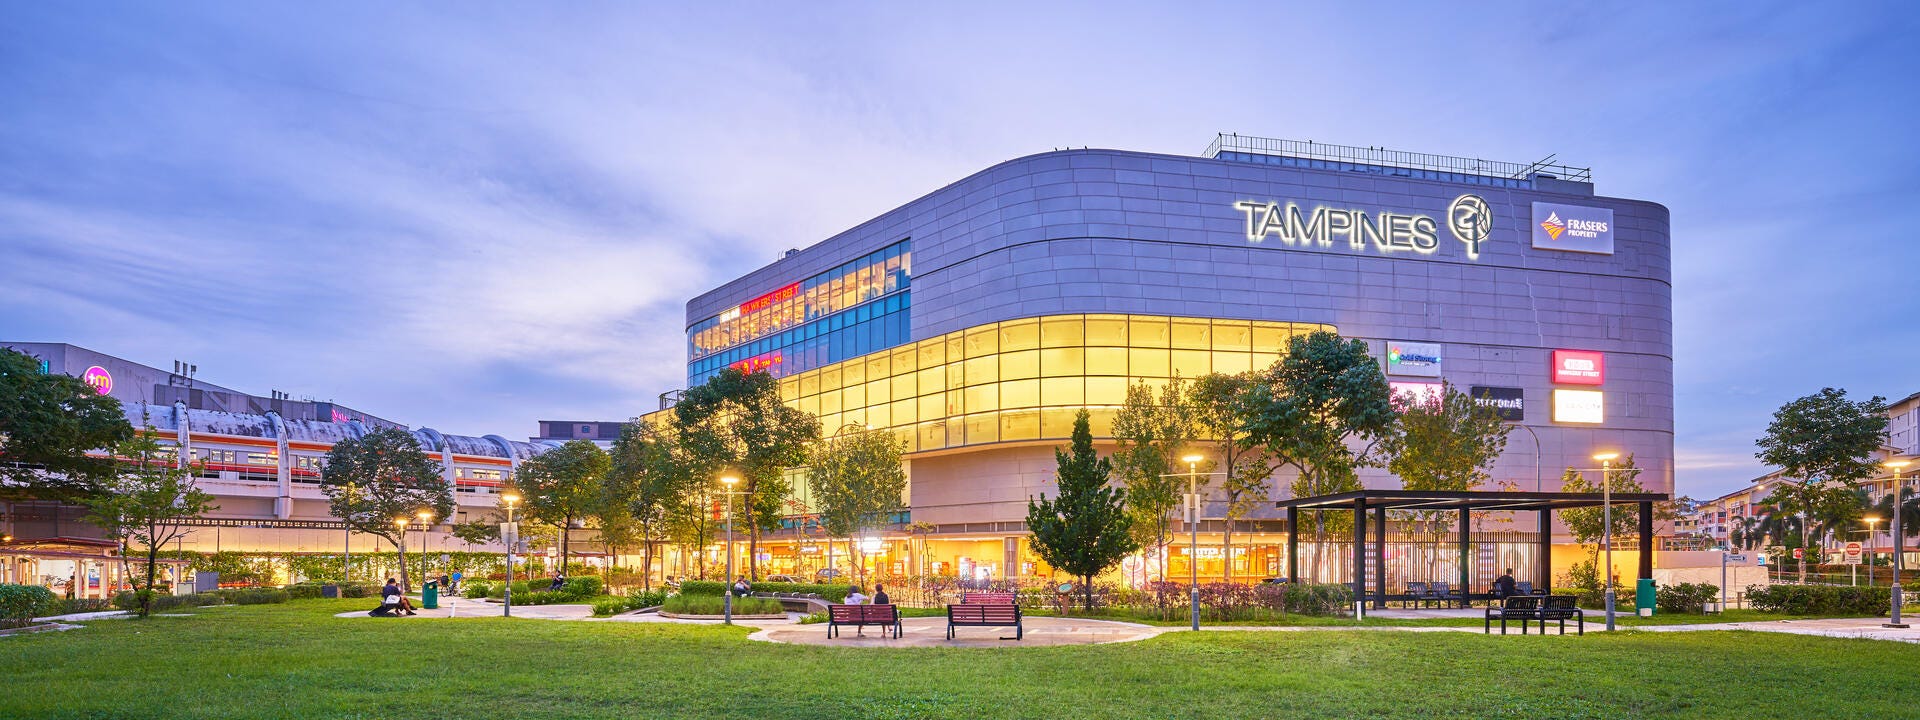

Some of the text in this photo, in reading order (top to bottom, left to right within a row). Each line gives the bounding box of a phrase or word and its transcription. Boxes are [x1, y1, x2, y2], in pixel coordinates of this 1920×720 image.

[1238, 201, 1438, 250] TAMPINES
[1567, 219, 1608, 233] FRASERS
[1567, 229, 1598, 239] PROPERTY
[775, 285, 799, 302] STREET
